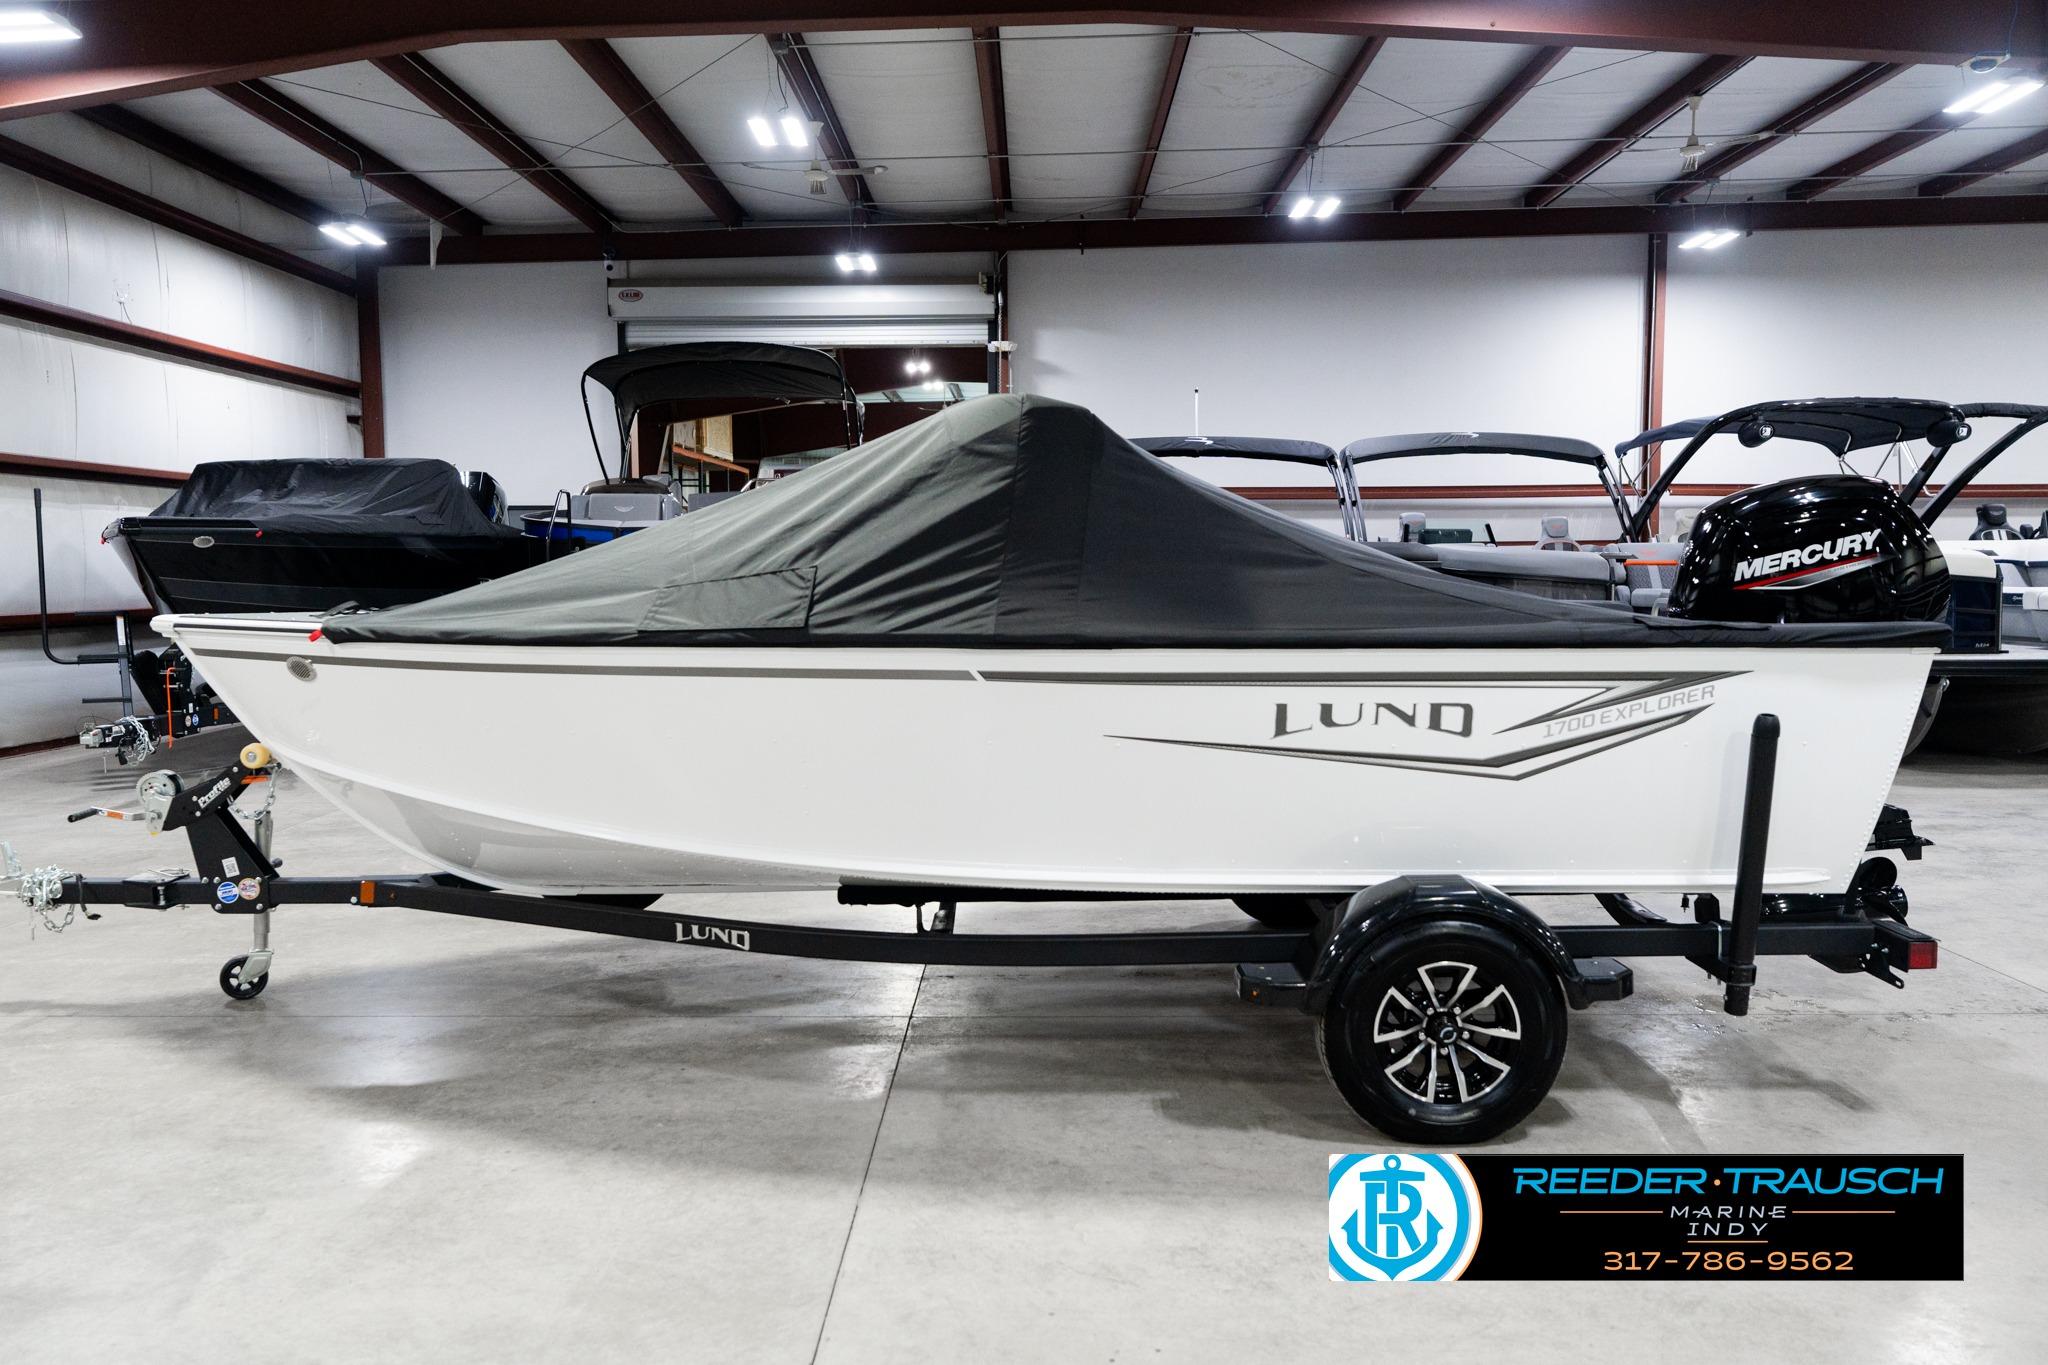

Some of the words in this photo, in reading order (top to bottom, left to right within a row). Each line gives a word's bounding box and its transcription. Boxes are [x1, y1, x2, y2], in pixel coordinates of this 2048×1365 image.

[1734, 528, 1882, 582] MERCURY
[1272, 702, 1474, 738] LUND
[1542, 713, 1596, 739] 1700
[1599, 684, 1717, 726] EXPLORER
[197, 776, 232, 809] Profile
[674, 922, 750, 952] LUND
